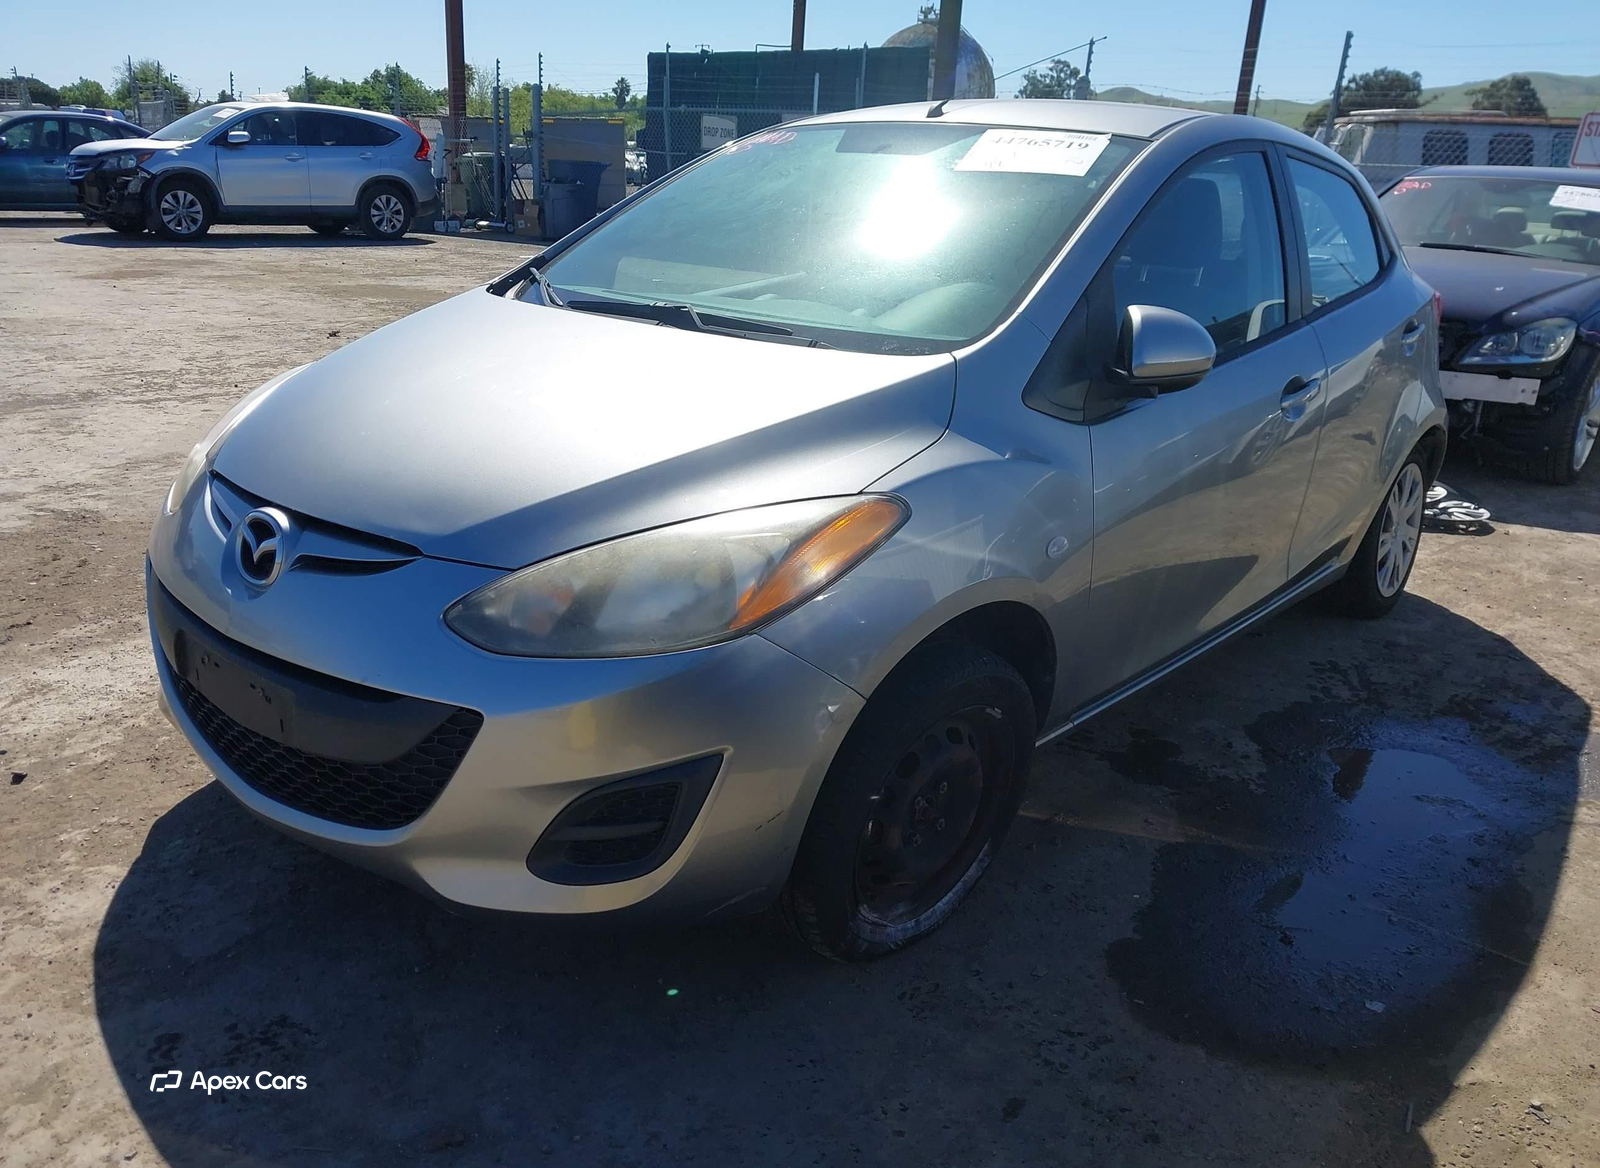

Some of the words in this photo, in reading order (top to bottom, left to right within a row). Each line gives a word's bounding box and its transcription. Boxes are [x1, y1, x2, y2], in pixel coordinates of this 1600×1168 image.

[703, 126, 719, 137] DROP
[720, 127, 735, 139] ZONE
[1584, 121, 1600, 137] ST
